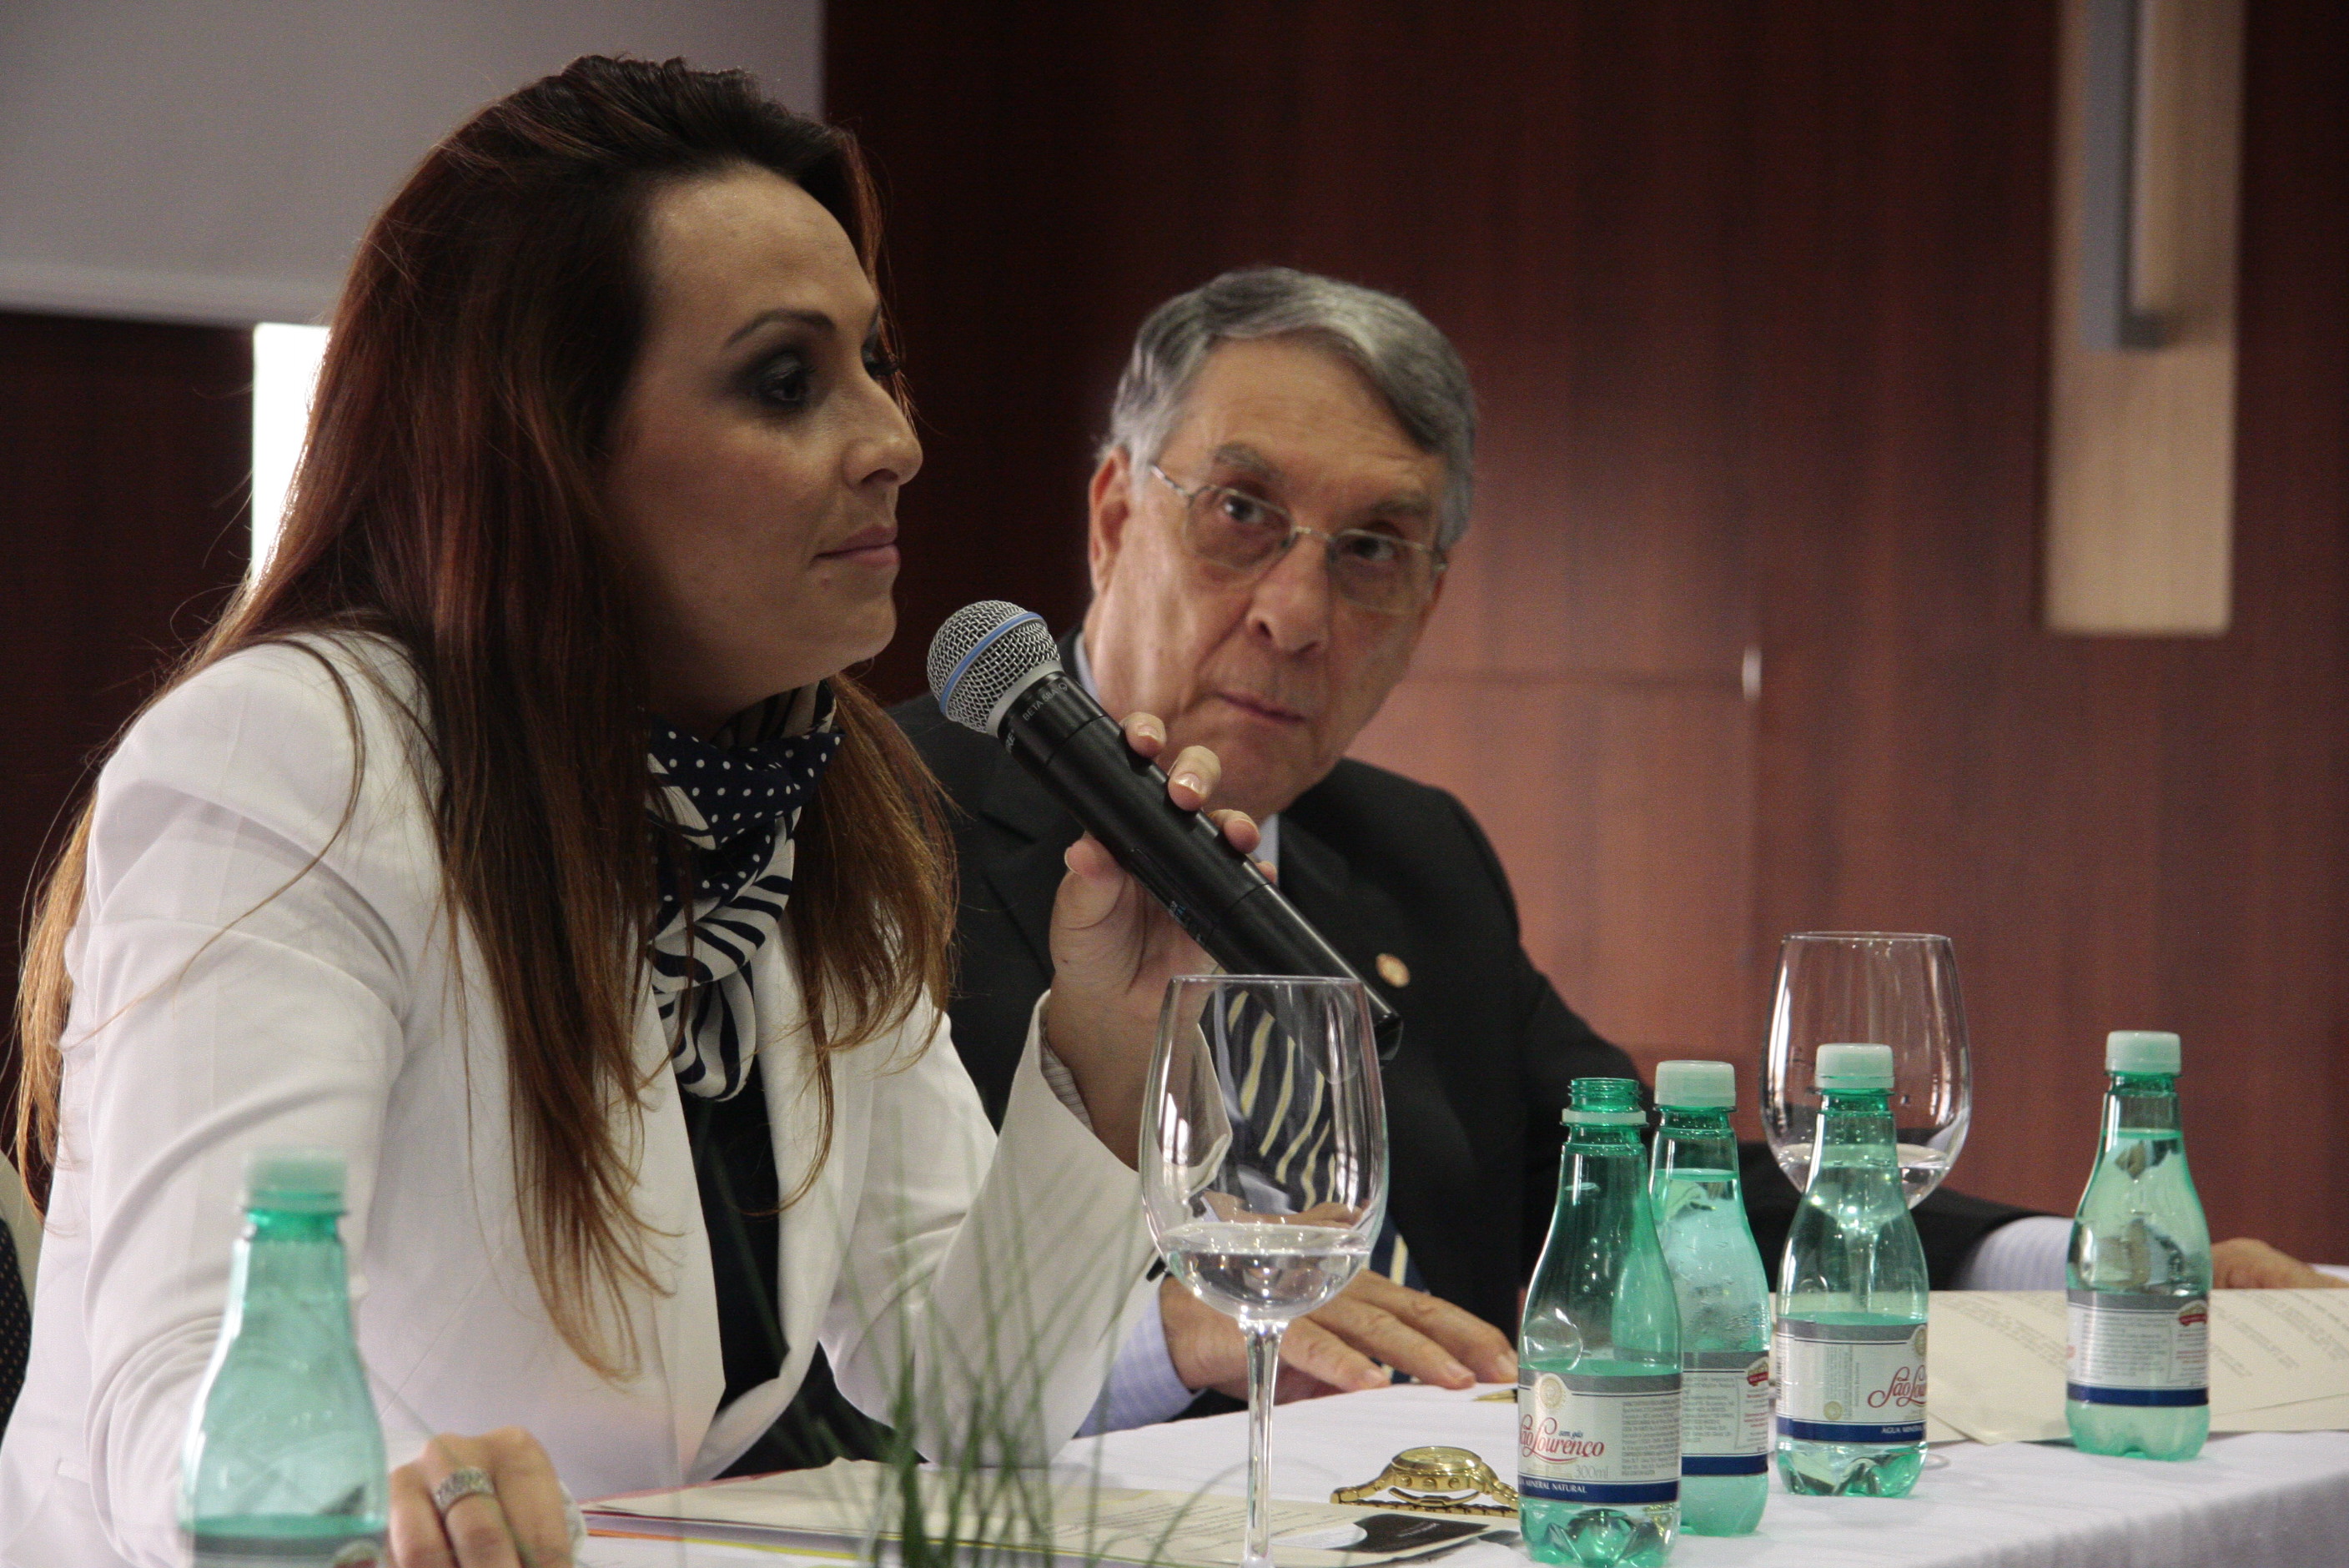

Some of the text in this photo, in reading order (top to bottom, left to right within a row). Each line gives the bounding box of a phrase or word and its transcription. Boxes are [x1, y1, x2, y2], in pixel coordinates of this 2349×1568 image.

[1022, 689, 1059, 721] BETA 58A
[1526, 1480, 1550, 1490] MINERAL
[1552, 1483, 1587, 1493] NATURAL
